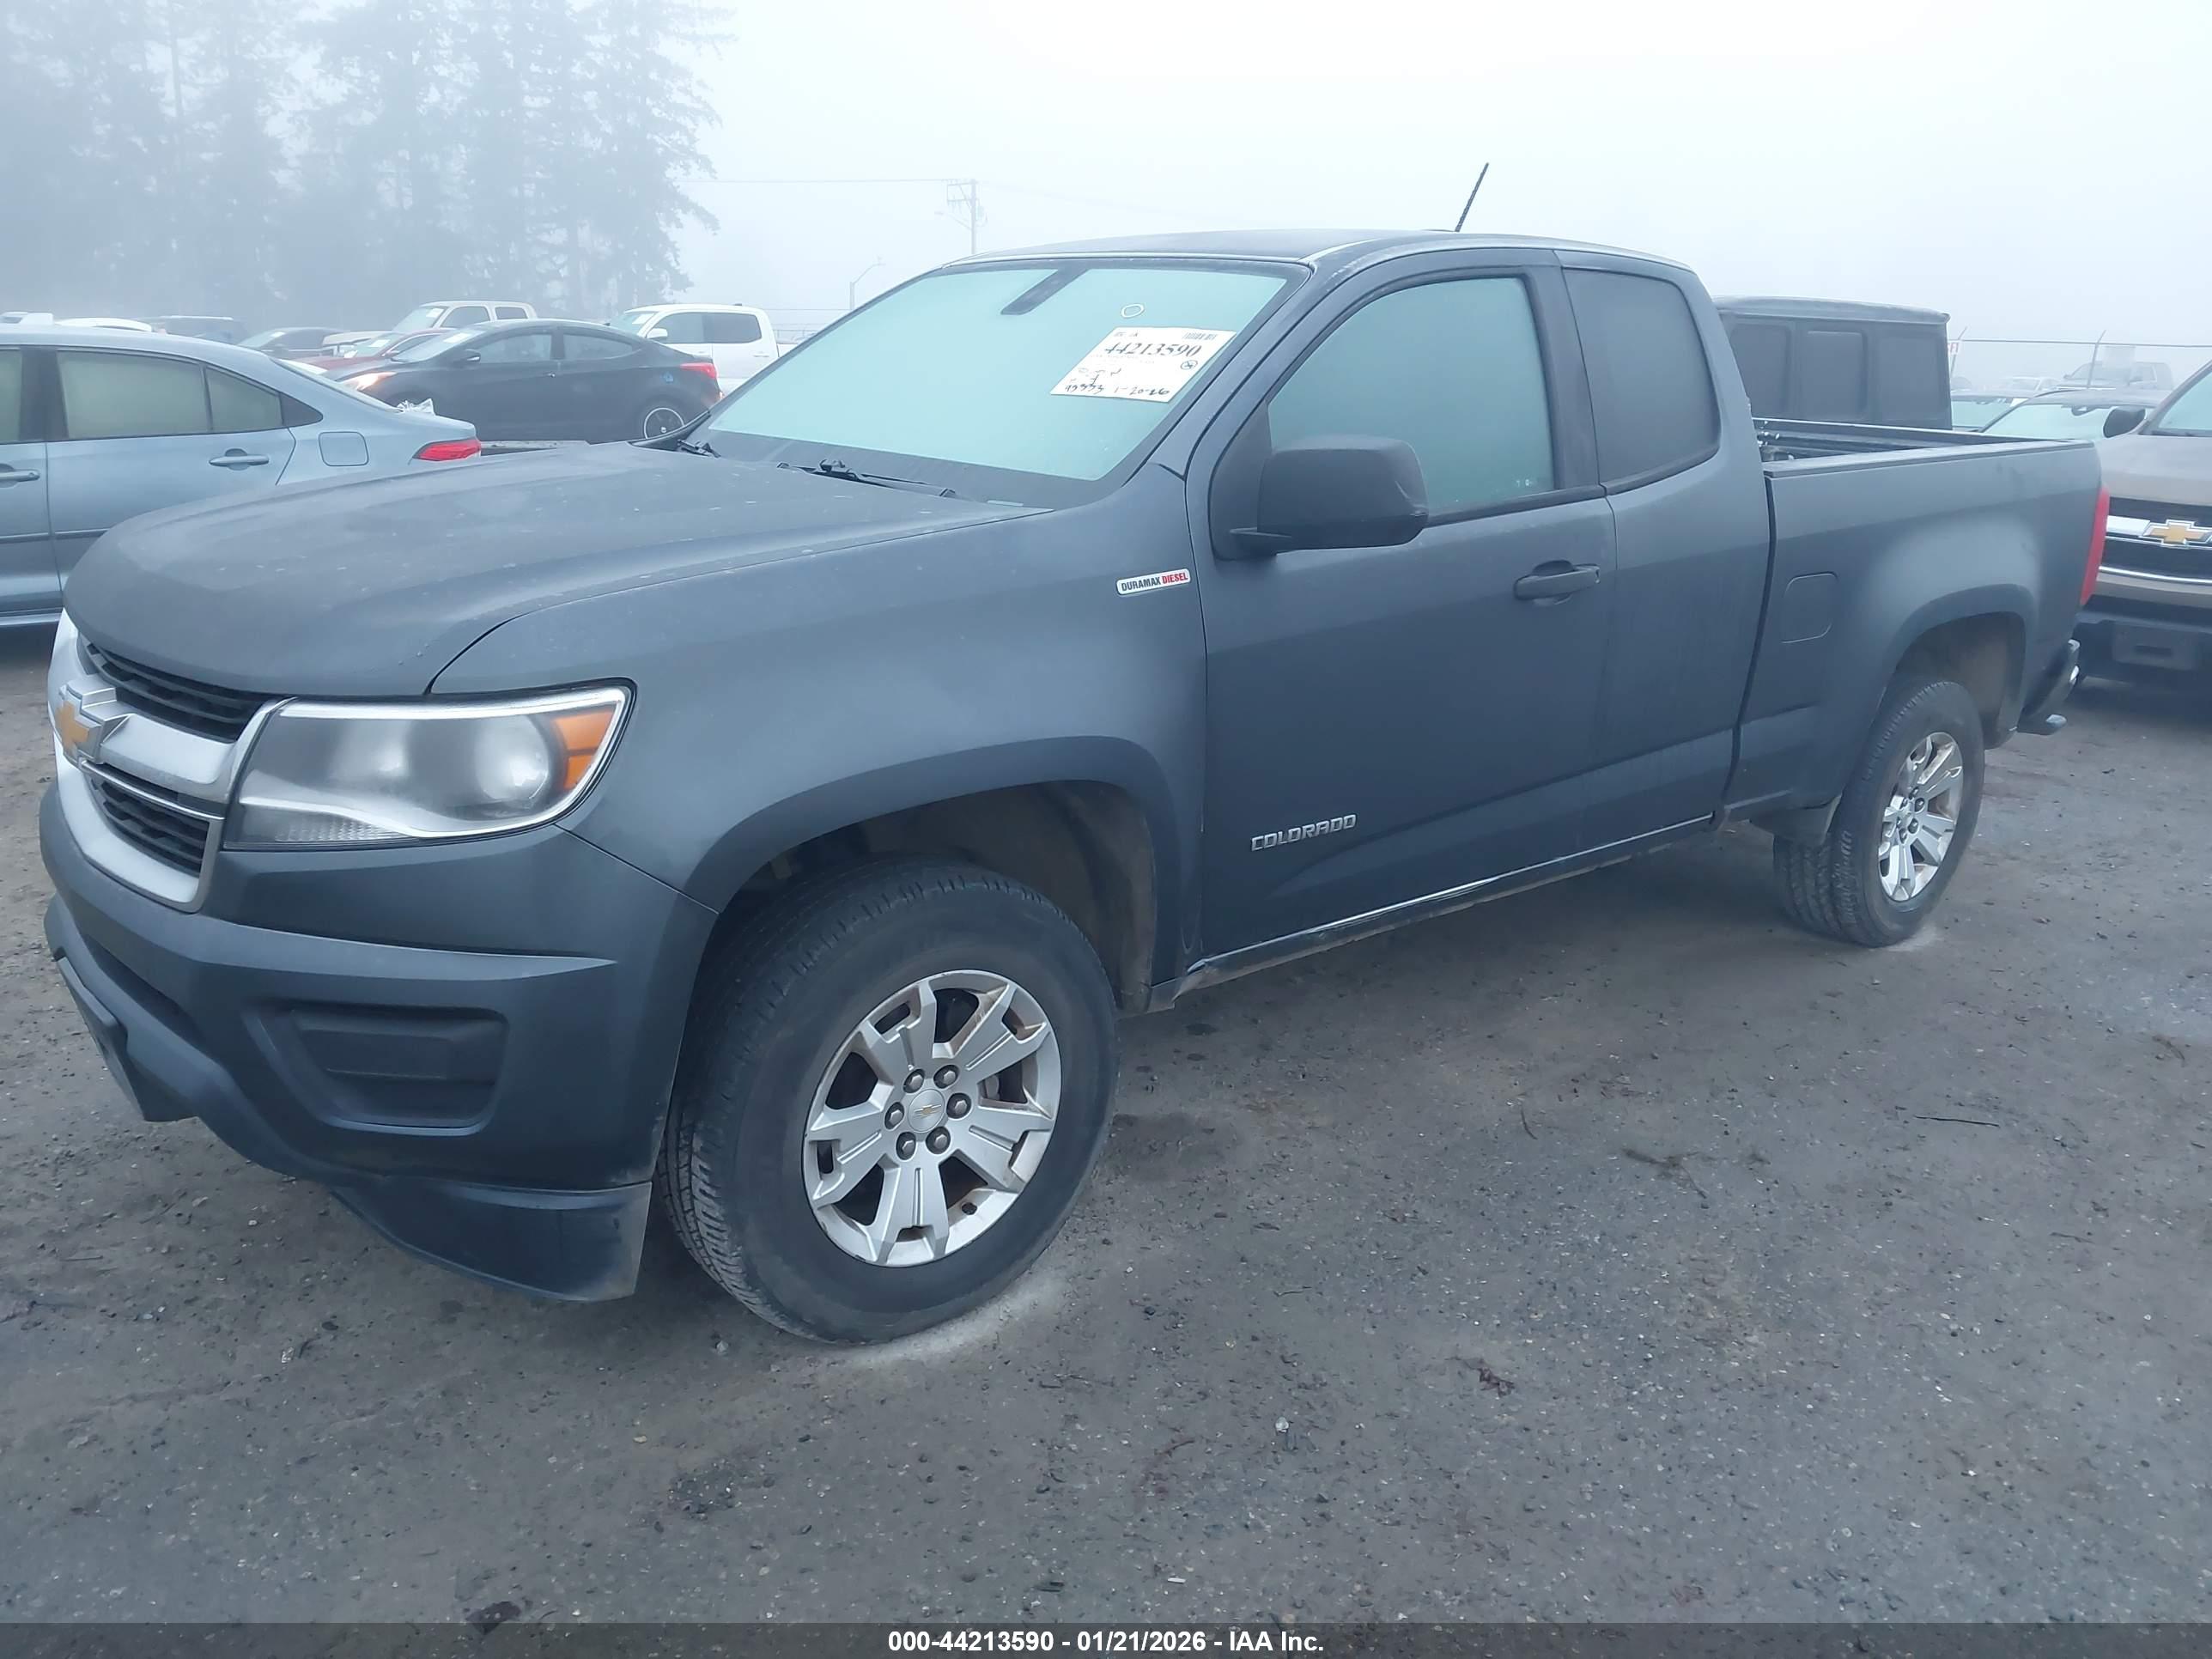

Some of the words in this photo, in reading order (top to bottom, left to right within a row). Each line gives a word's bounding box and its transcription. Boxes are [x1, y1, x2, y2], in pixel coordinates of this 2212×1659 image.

[1104, 342, 1202, 357] 44213590
[1121, 576, 1161, 592] DURAMAX
[1161, 572, 1188, 584] DIESEL
[1251, 814, 1357, 851] COLORADO
